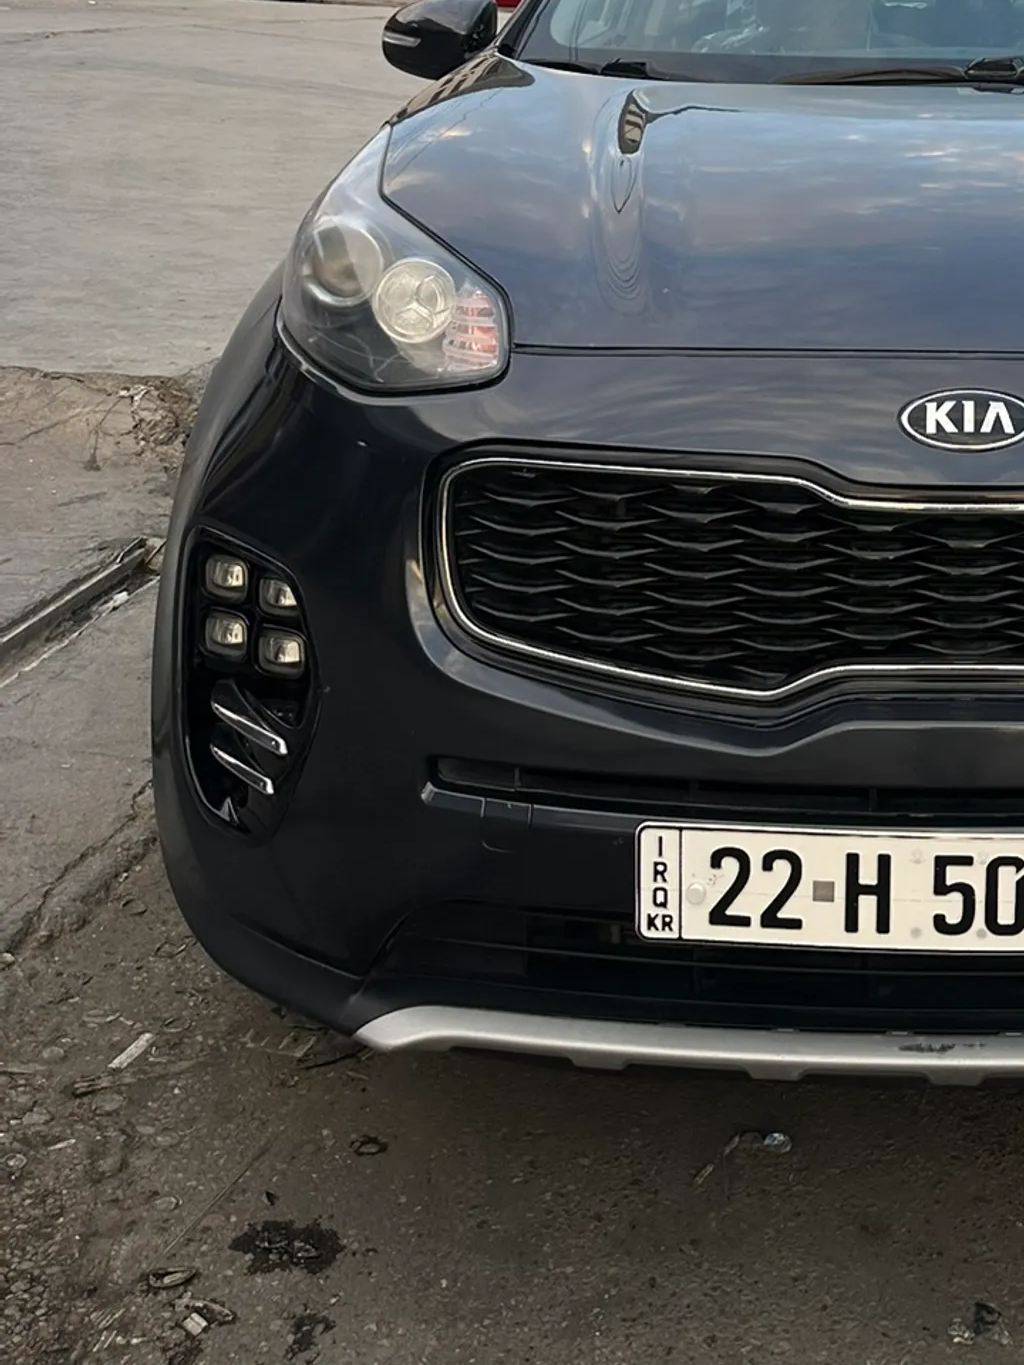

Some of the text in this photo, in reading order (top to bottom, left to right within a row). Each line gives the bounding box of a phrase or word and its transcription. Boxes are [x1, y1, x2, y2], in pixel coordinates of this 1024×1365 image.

[924, 400, 1016, 435] KIA
[708, 846, 803, 931] 22
[843, 851, 892, 935] H
[646, 913, 674, 932] KR
